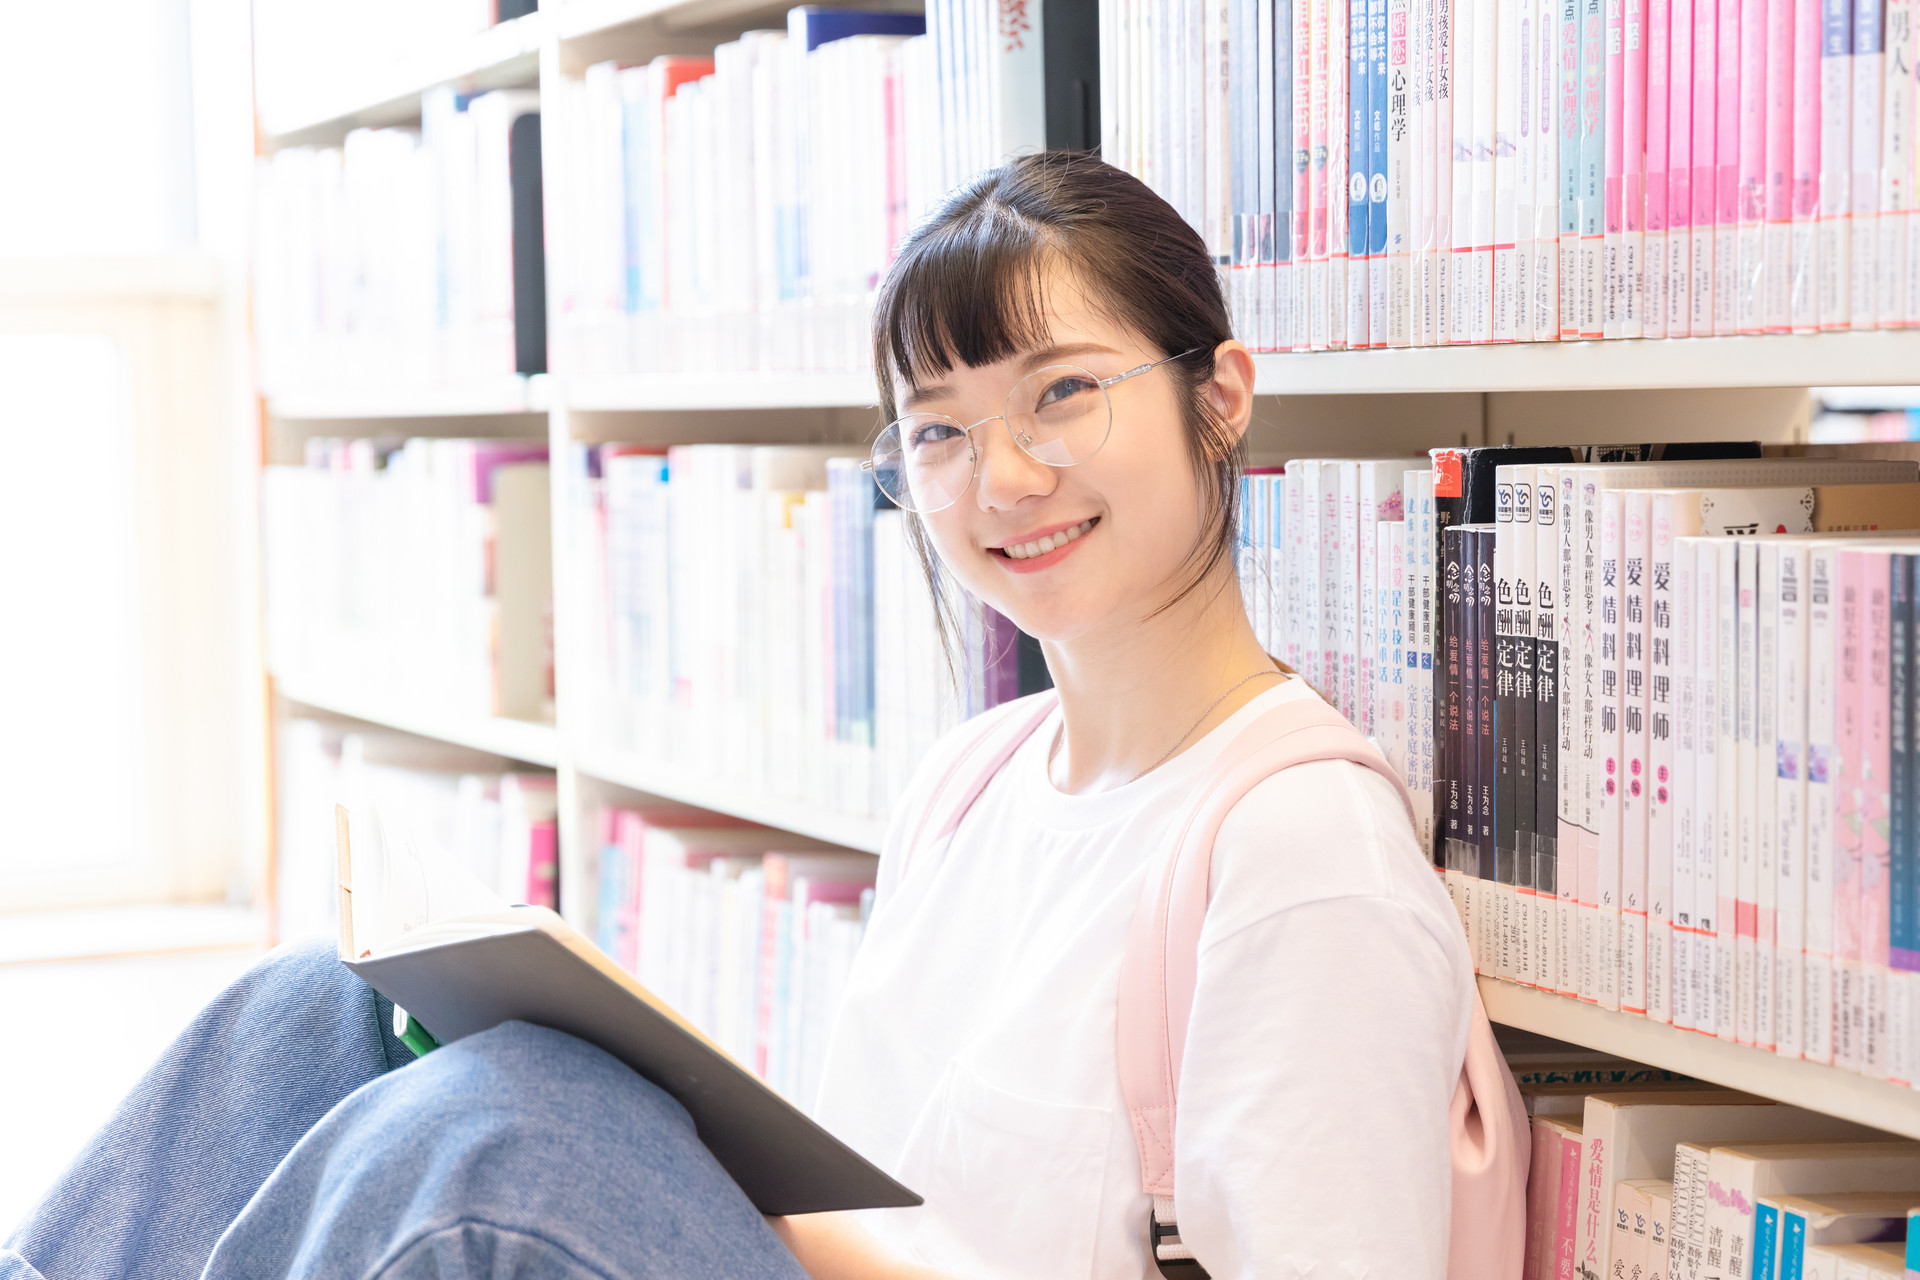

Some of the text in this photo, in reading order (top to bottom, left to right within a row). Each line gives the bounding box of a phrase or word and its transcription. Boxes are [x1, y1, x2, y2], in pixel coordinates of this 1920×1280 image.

[1391, 12, 1406, 142] 婚恋心理学
[1425, 0, 1434, 102] 男孩爱上女孩
[1438, 0, 1449, 100] 男孩爱上女孩
[1562, 503, 1571, 608] 像男人那样思考
[1584, 509, 1594, 615] 像男人那样思考
[1392, 543, 1402, 685] 恋爱是个技术活
[1496, 578, 1514, 697] 色酬定律
[1515, 578, 1533, 699] 色酬定律
[1537, 581, 1555, 703] 色酬定律
[1602, 559, 1617, 735] 爱情料理师
[1627, 557, 1643, 735] 爱情料理师
[1653, 562, 1671, 742] 爱情料理师
[1449, 636, 1459, 731] 给爱情一个说法
[1481, 639, 1490, 736] 给爱情一个说法
[1562, 646, 1571, 752] 像女人那样行动
[1584, 653, 1594, 760] 像女人那样行动
[1407, 684, 1418, 790] 完美家庭密码
[1422, 685, 1432, 793] 完美家庭密码
[1450, 780, 1458, 830] 王为念 著
[1467, 824, 1473, 835] 著
[1482, 825, 1489, 836] 著
[1586, 1138, 1604, 1265] 爱情是什么
[1707, 1225, 1723, 1269] 清醒
[1561, 1236, 1574, 1278] 不要
[1614, 1258, 1625, 1280] 爱
[1729, 1234, 1744, 1278] 清醒
